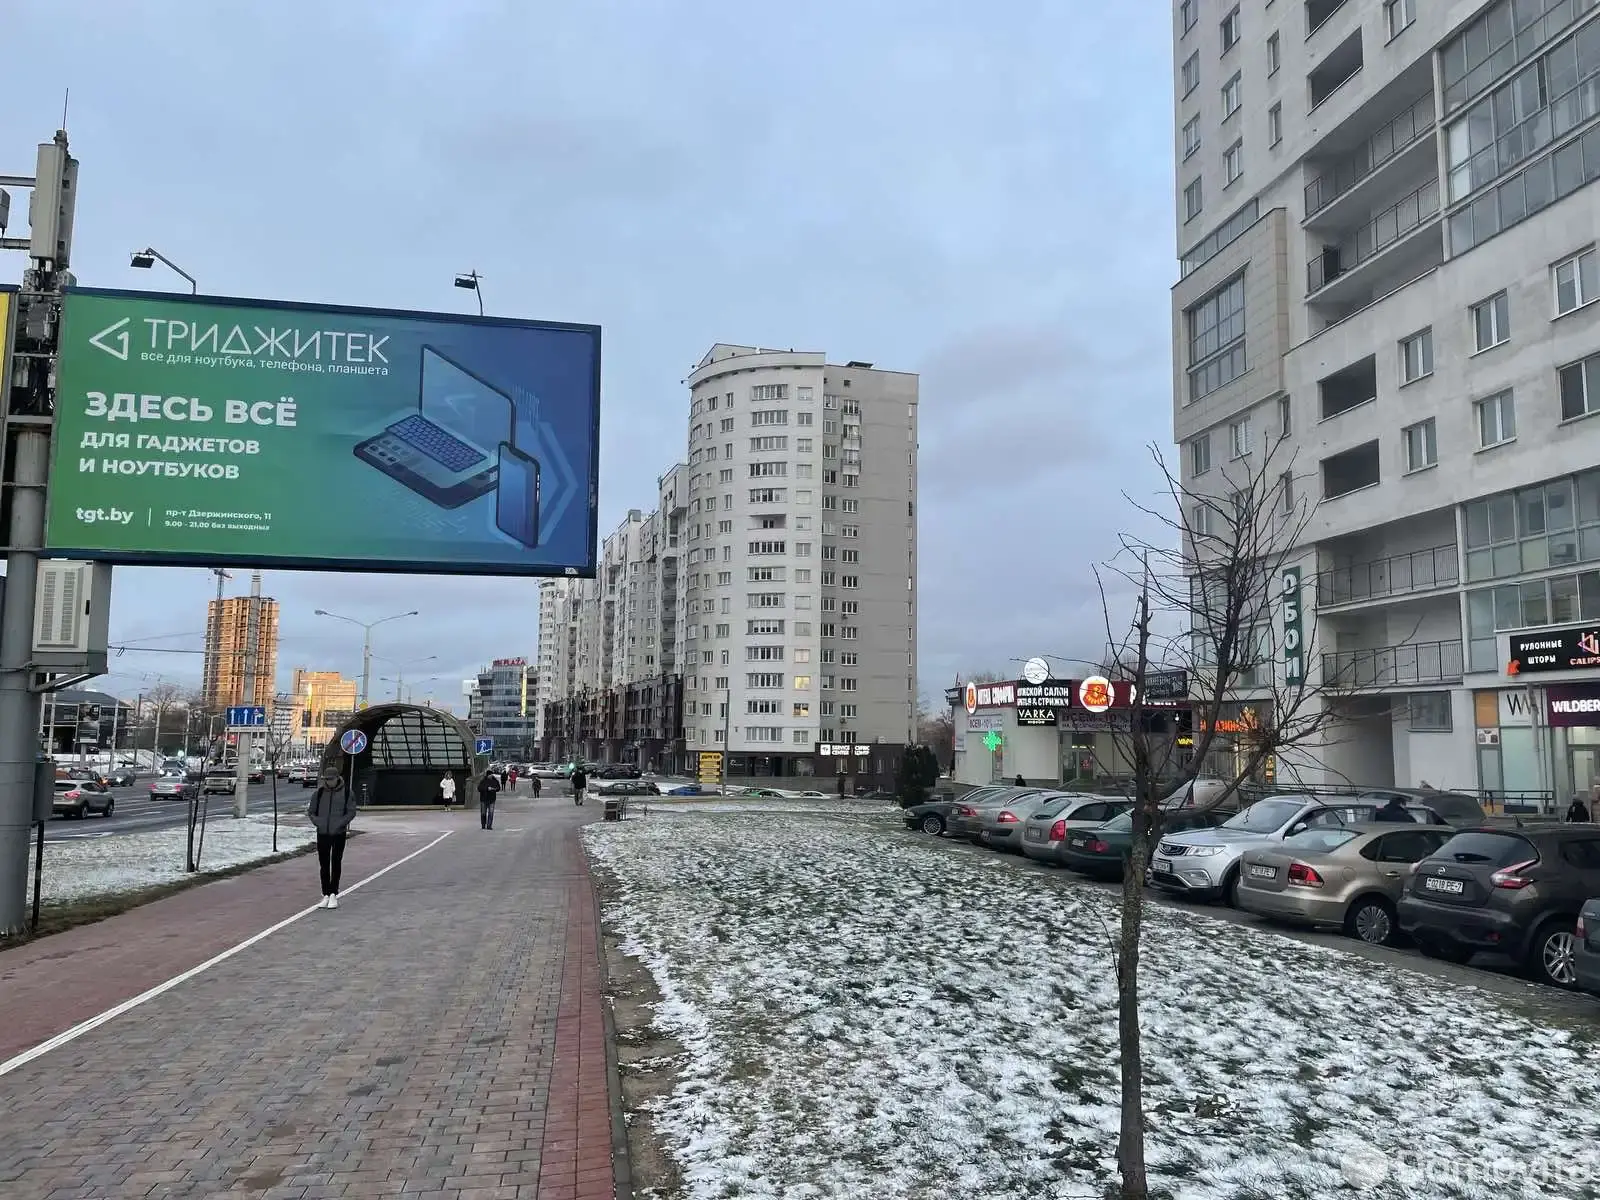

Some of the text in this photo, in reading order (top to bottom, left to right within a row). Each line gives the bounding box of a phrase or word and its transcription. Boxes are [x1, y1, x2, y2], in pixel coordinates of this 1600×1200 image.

[144, 318, 390, 364] ТРИДЖИТЕК
[167, 353, 191, 364] для
[195, 355, 256, 369] ноутбука,
[259, 359, 325, 373] телефона,
[328, 364, 388, 376] планшета
[84, 391, 297, 427] ЗДЕСЬ ВСЁ
[80, 431, 261, 455] ДЛЯ ГАДЖЕТОВ
[79, 458, 240, 480] И НОУТБУКОВ
[76, 507, 134, 524] tgt.by
[165, 509, 187, 517] пр-т
[188, 509, 262, 520] Дзержинского,
[1520, 640, 1562, 651] РУЛОННЫЕ
[1528, 655, 1556, 665] ШТОРЫ
[1018, 709, 1055, 719] VARKA
